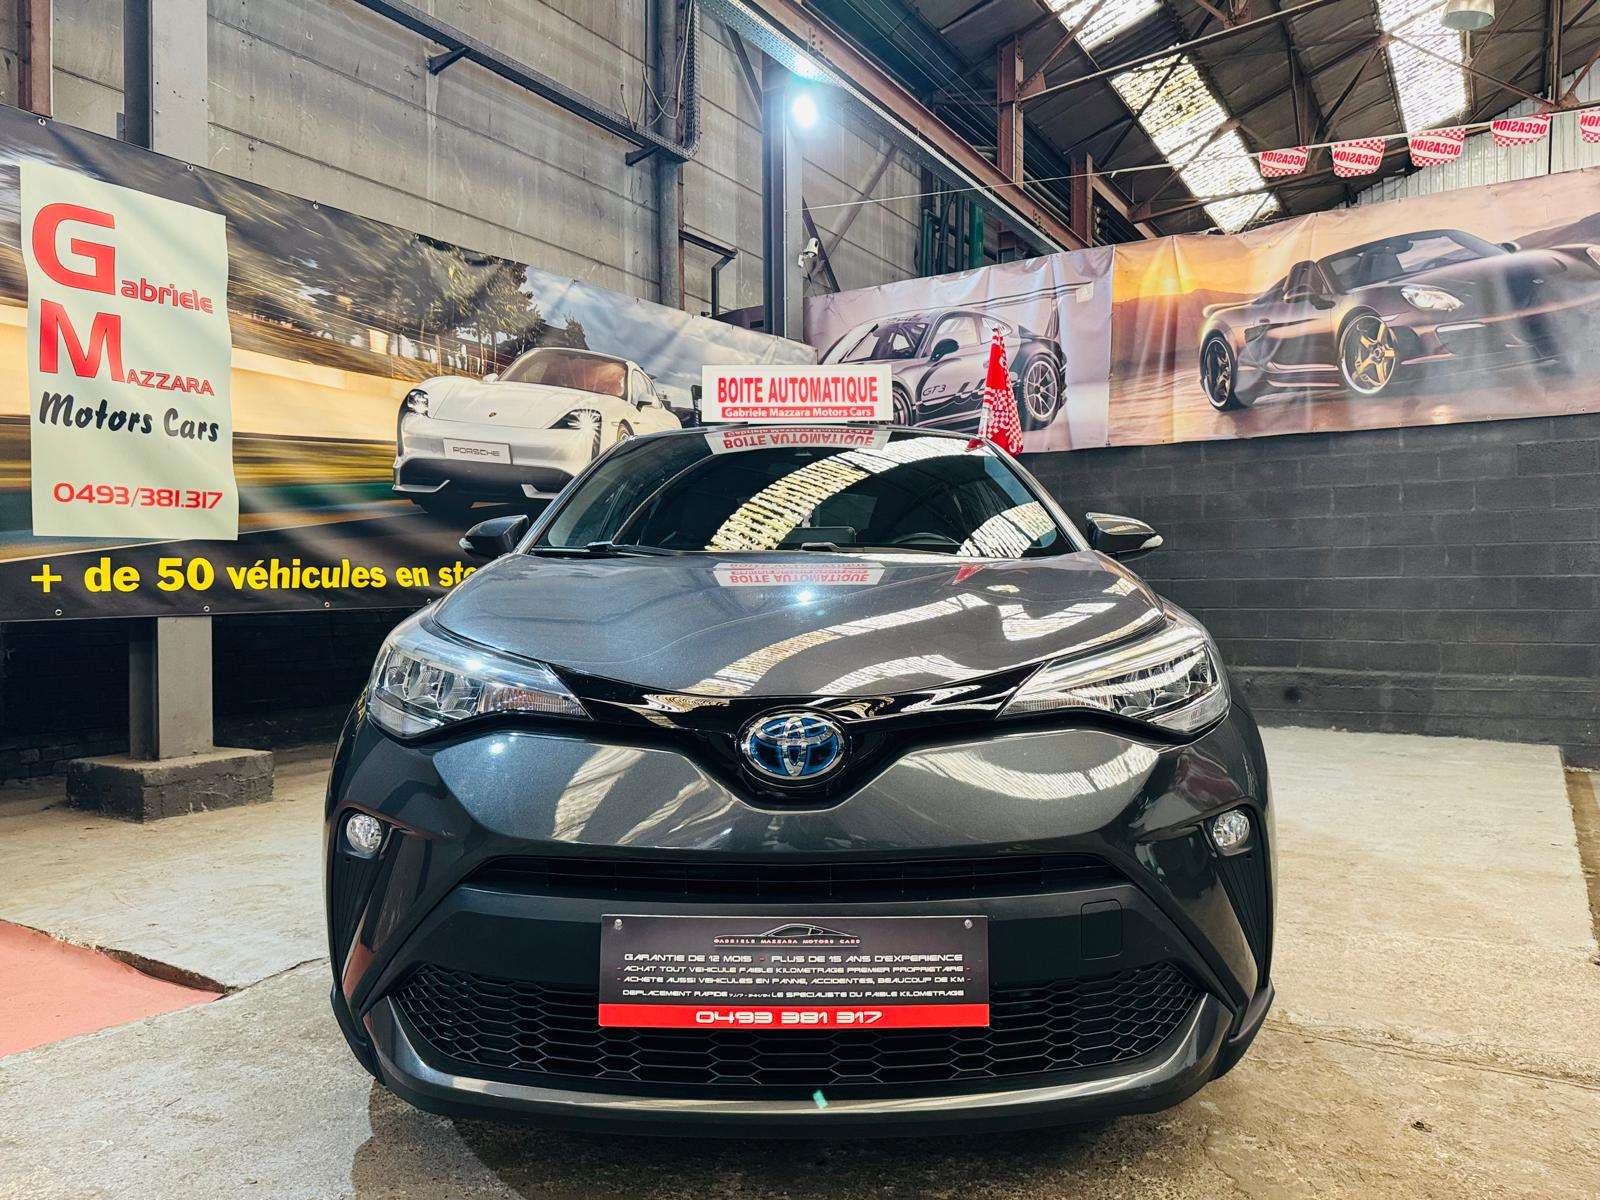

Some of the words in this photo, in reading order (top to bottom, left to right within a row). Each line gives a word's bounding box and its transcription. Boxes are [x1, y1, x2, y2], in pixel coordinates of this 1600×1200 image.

[32, 202, 214, 314] Gabriele
[717, 377, 764, 403] BOITE
[768, 376, 878, 403] AUTOMATIQUE
[922, 384, 947, 397] GT3
[39, 391, 153, 435] Motors
[163, 407, 220, 442] Cars
[724, 407, 768, 418] Gabriele
[769, 407, 811, 417] Mazzara
[812, 407, 848, 417] Motors
[850, 407, 872, 416] Cars
[452, 446, 500, 457] PORSCHE
[53, 482, 224, 510] 0493/381.317
[31, 564, 62, 593] +
[84, 557, 141, 593] de
[156, 557, 215, 592] 50
[226, 558, 388, 591] véhicules
[395, 565, 430, 588] en
[624, 953, 685, 962] GARANTIE
[688, 954, 705, 962] DE
[708, 955, 720, 963] 12
[723, 955, 752, 963] MOIS
[771, 955, 805, 963] PLUS
[808, 955, 826, 963] DE
[845, 955, 871, 963] ANS
[874, 954, 963, 963] D'EXPERIENCE
[623, 965, 657, 973] ACHAT
[689, 966, 737, 974] VEHICULE
[666, 976, 696, 984] AUSSI
[811, 977, 875, 986] ACCIDENTES,
[877, 976, 932, 984] BEAUCOUP
[622, 989, 692, 997] DEPLACEMENT
[693, 990, 728, 998] RAPIDE
[899, 990, 965, 998] KILOMETRAGE
[695, 1011, 773, 1024] 0493
[781, 1011, 829, 1024] 381
[836, 1011, 884, 1024] 317
